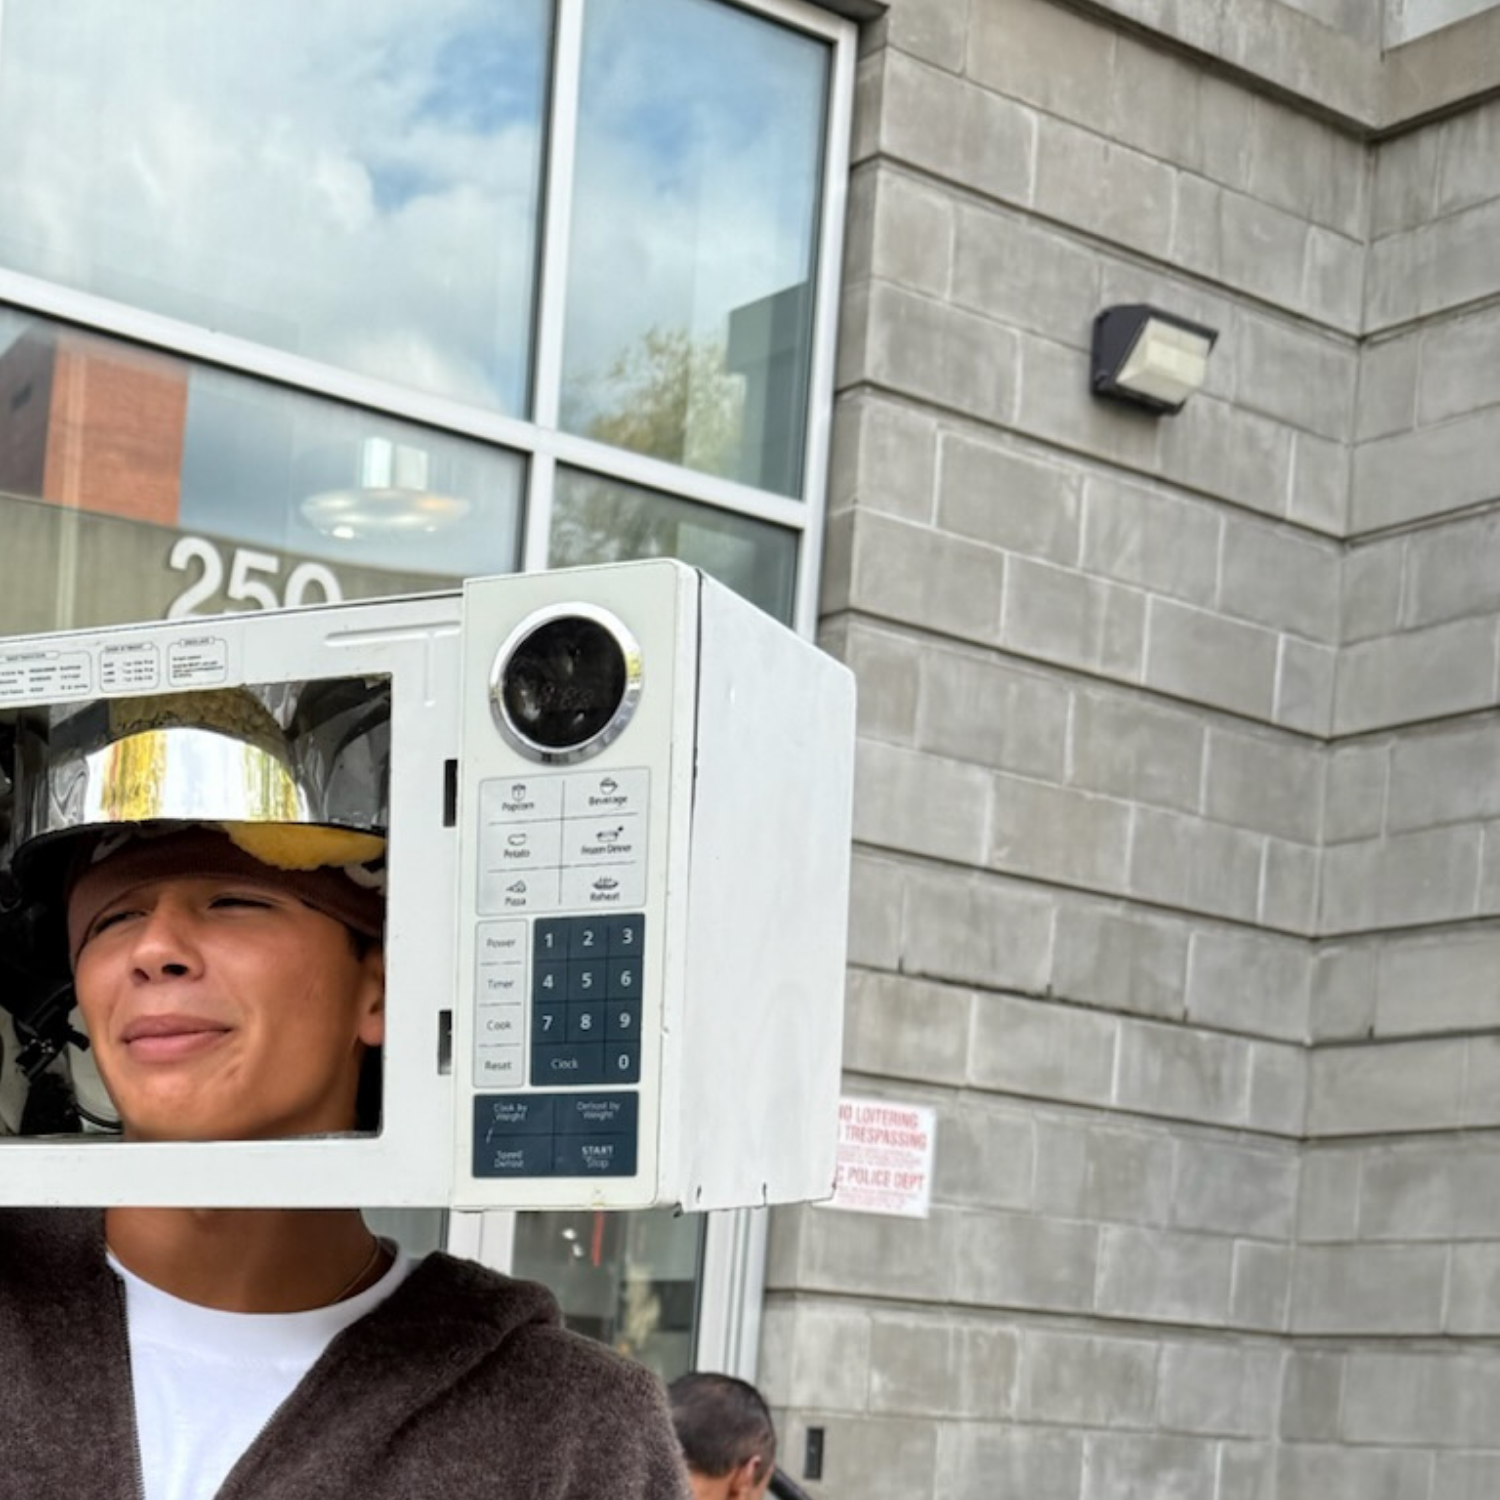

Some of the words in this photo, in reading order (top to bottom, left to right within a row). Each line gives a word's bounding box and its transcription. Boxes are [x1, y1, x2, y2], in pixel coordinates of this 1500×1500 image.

[502, 801, 534, 812] Popcorn
[588, 795, 628, 807] Beverage
[504, 849, 530, 858] Potato
[487, 938, 516, 948] Power
[545, 933, 553, 947] 1
[583, 931, 594, 946] 2
[622, 929, 633, 943] 3
[487, 979, 514, 989] Timer
[542, 974, 553, 988] 4
[582, 973, 592, 988] 5
[621, 971, 631, 986] 6
[486, 1020, 511, 1031] Cook
[543, 1016, 553, 1030] 7
[580, 1014, 591, 1029] 8
[620, 1013, 631, 1028] 9
[484, 1060, 512, 1071] Reset
[551, 1057, 578, 1069] Clock
[619, 1055, 629, 1069] 0
[845, 1125, 927, 1151] TRESPASSING
[581, 1145, 613, 1155] START
[847, 1166, 891, 1188] POLICE
